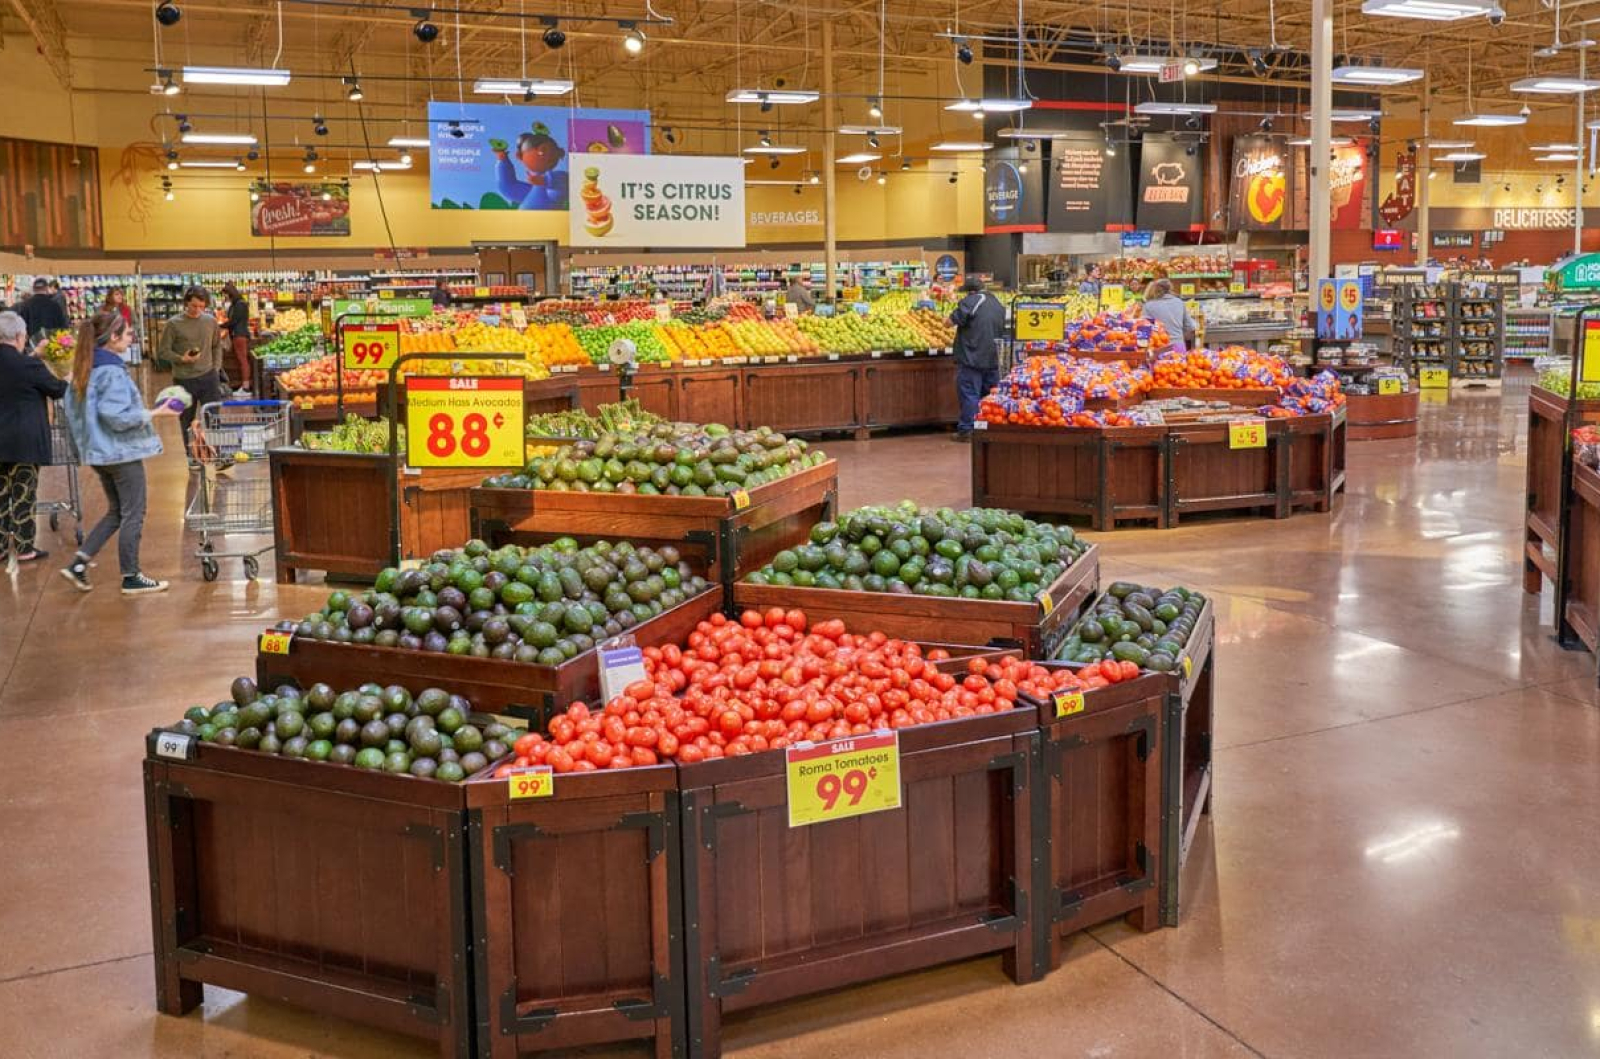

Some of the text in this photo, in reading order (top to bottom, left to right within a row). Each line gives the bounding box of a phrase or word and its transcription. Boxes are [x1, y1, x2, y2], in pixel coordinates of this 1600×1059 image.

[621, 182, 733, 201] IT'S CITRUS
[633, 204, 720, 221] SEASON!
[751, 211, 819, 223] BEVERAGES
[449, 378, 479, 389] SALE
[448, 397, 471, 407] Hass
[473, 397, 521, 408] Avocados
[831, 741, 855, 753] SALE
[799, 752, 889, 776] Roma Tomatoes
